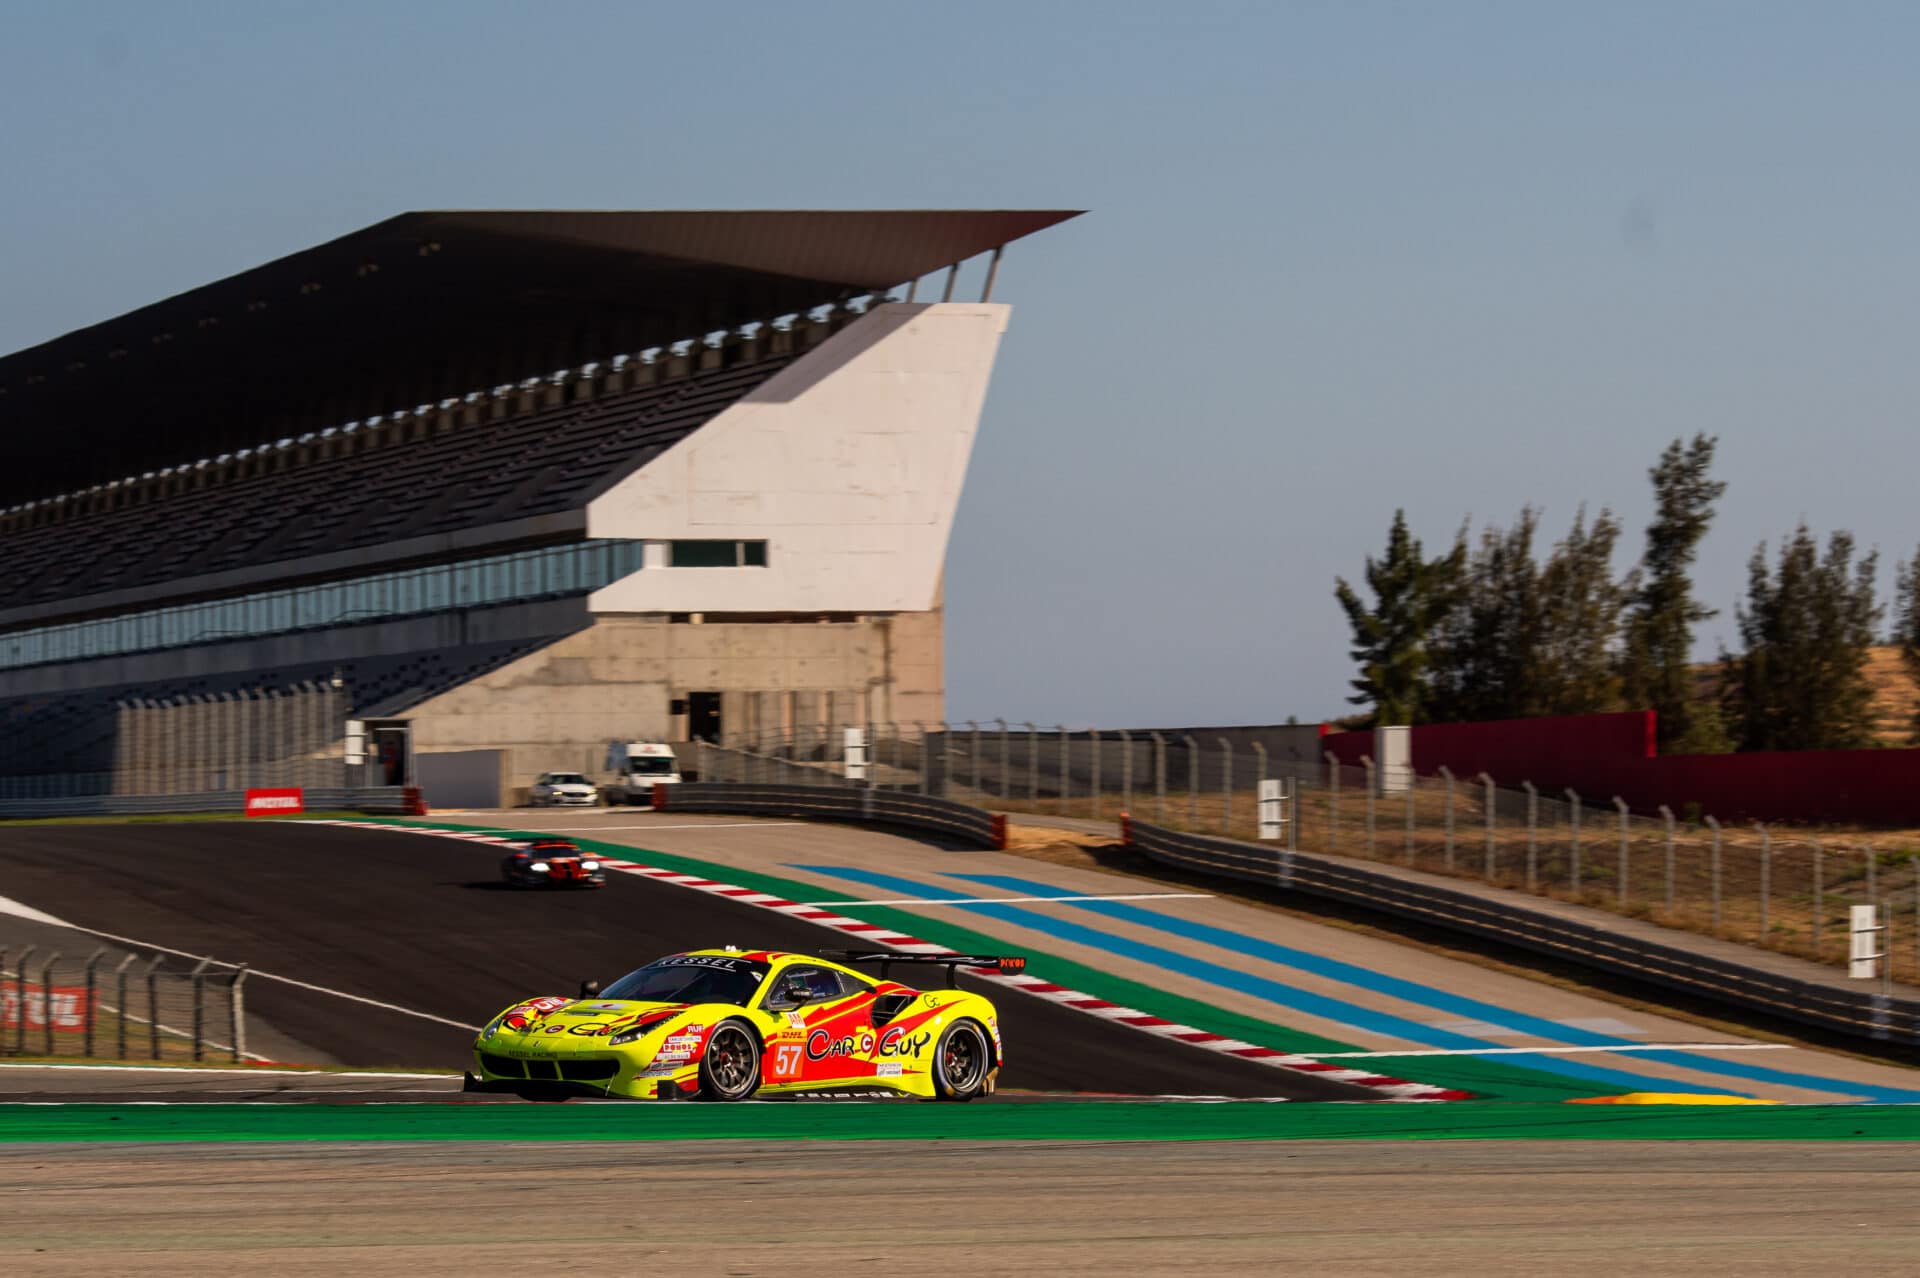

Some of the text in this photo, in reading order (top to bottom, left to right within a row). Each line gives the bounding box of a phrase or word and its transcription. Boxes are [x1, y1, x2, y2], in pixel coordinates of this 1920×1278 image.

[806, 1029, 855, 1061] CAR
[879, 1026, 931, 1058] GUY
[775, 1045, 802, 1075] 57
